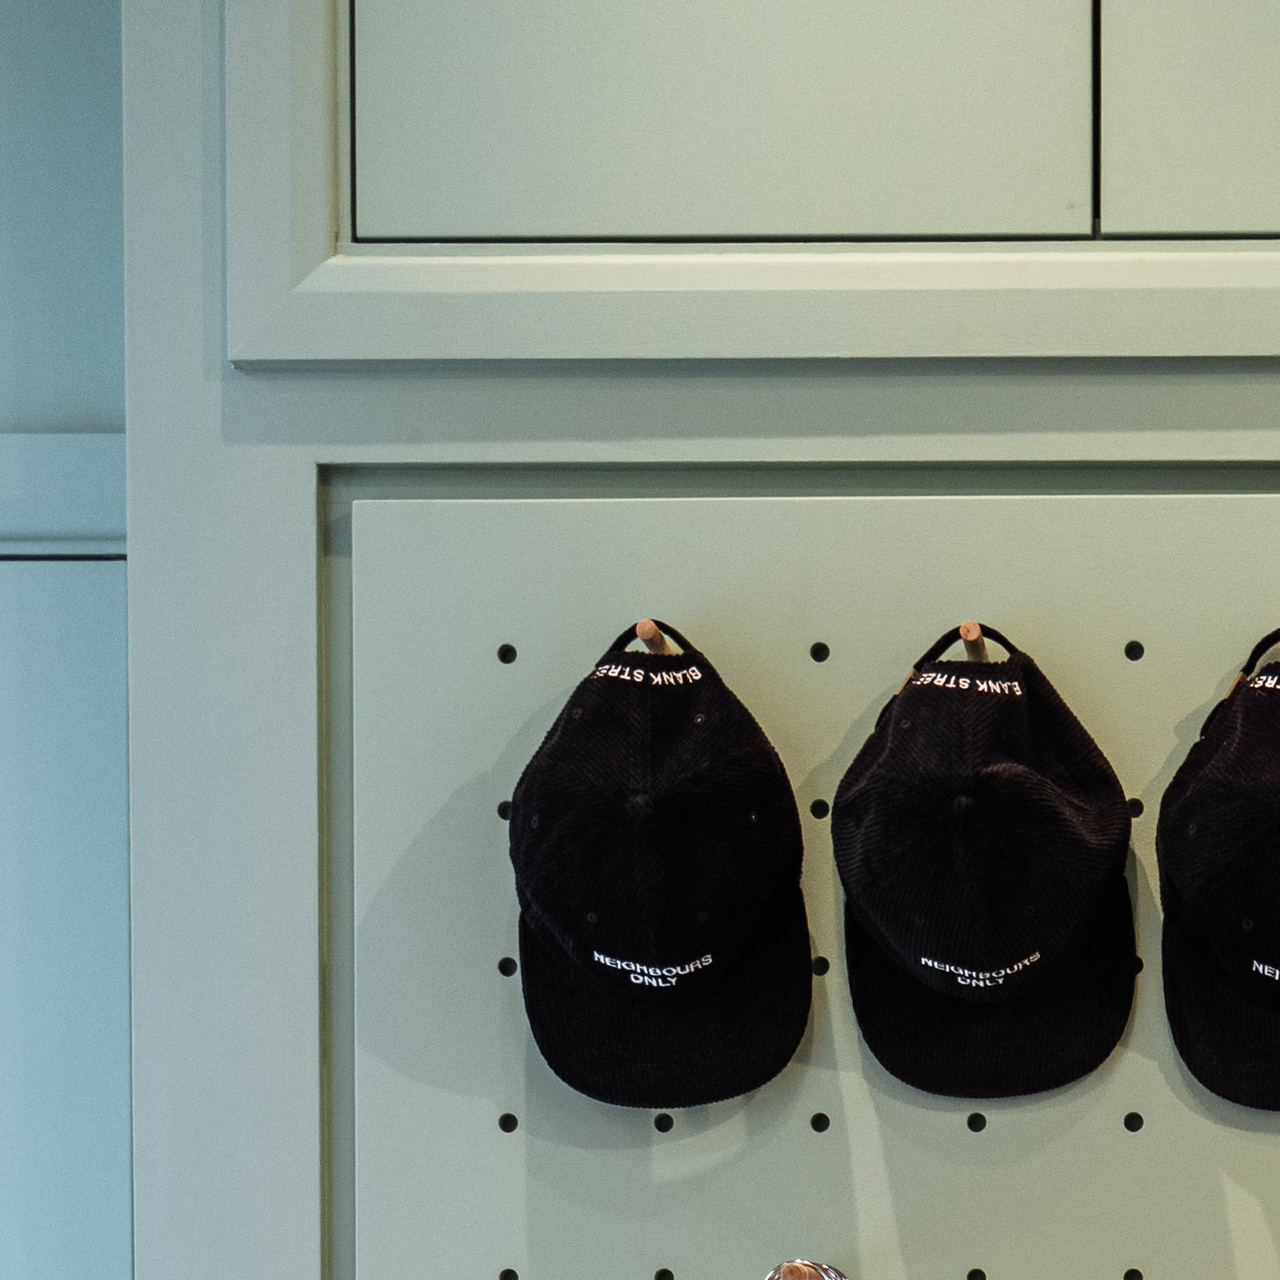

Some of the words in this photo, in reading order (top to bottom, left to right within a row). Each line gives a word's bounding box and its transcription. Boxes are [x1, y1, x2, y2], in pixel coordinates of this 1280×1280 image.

[589, 664, 645, 682] STRE
[648, 665, 702, 685] BLANK
[592, 948, 714, 977] NEIGHBOURS
[630, 973, 678, 988] ONLY
